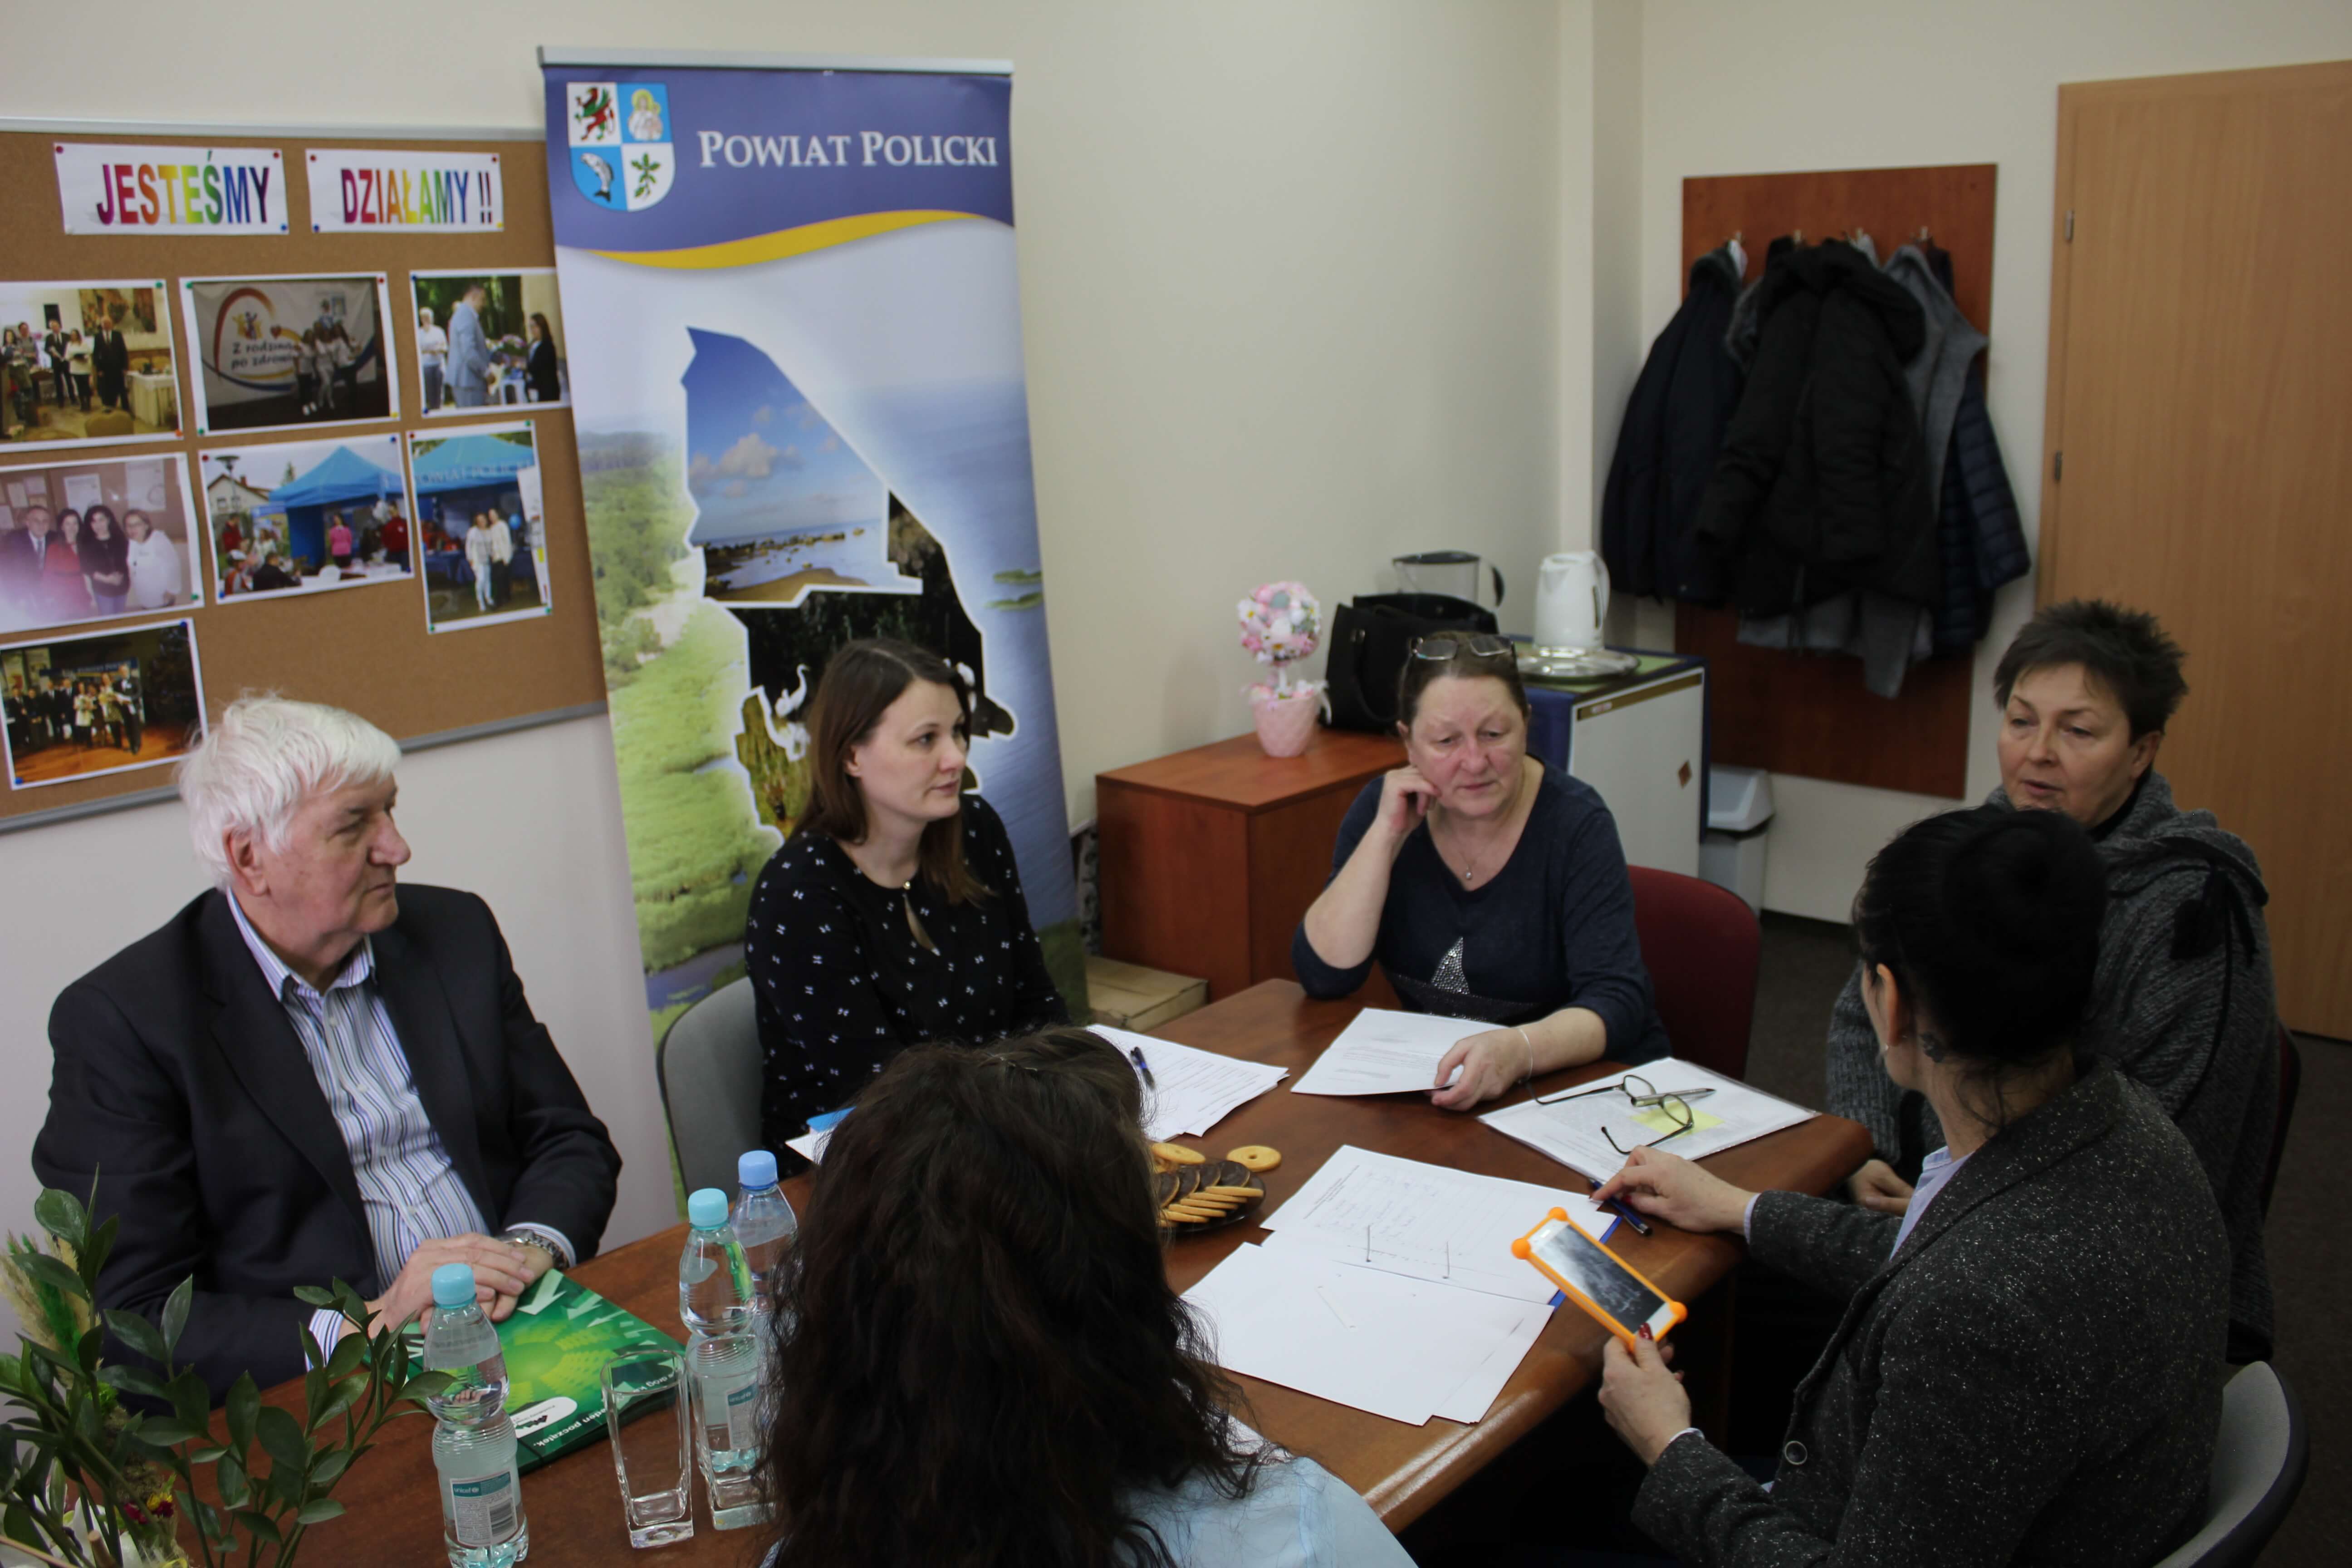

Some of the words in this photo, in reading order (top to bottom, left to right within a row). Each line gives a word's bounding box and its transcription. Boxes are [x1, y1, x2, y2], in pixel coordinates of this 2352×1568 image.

[697, 131, 852, 167] POWIAT
[860, 131, 998, 167] POLICKI
[96, 150, 270, 225] JESTEŚMY
[341, 168, 469, 224] DZIAŁAMY
